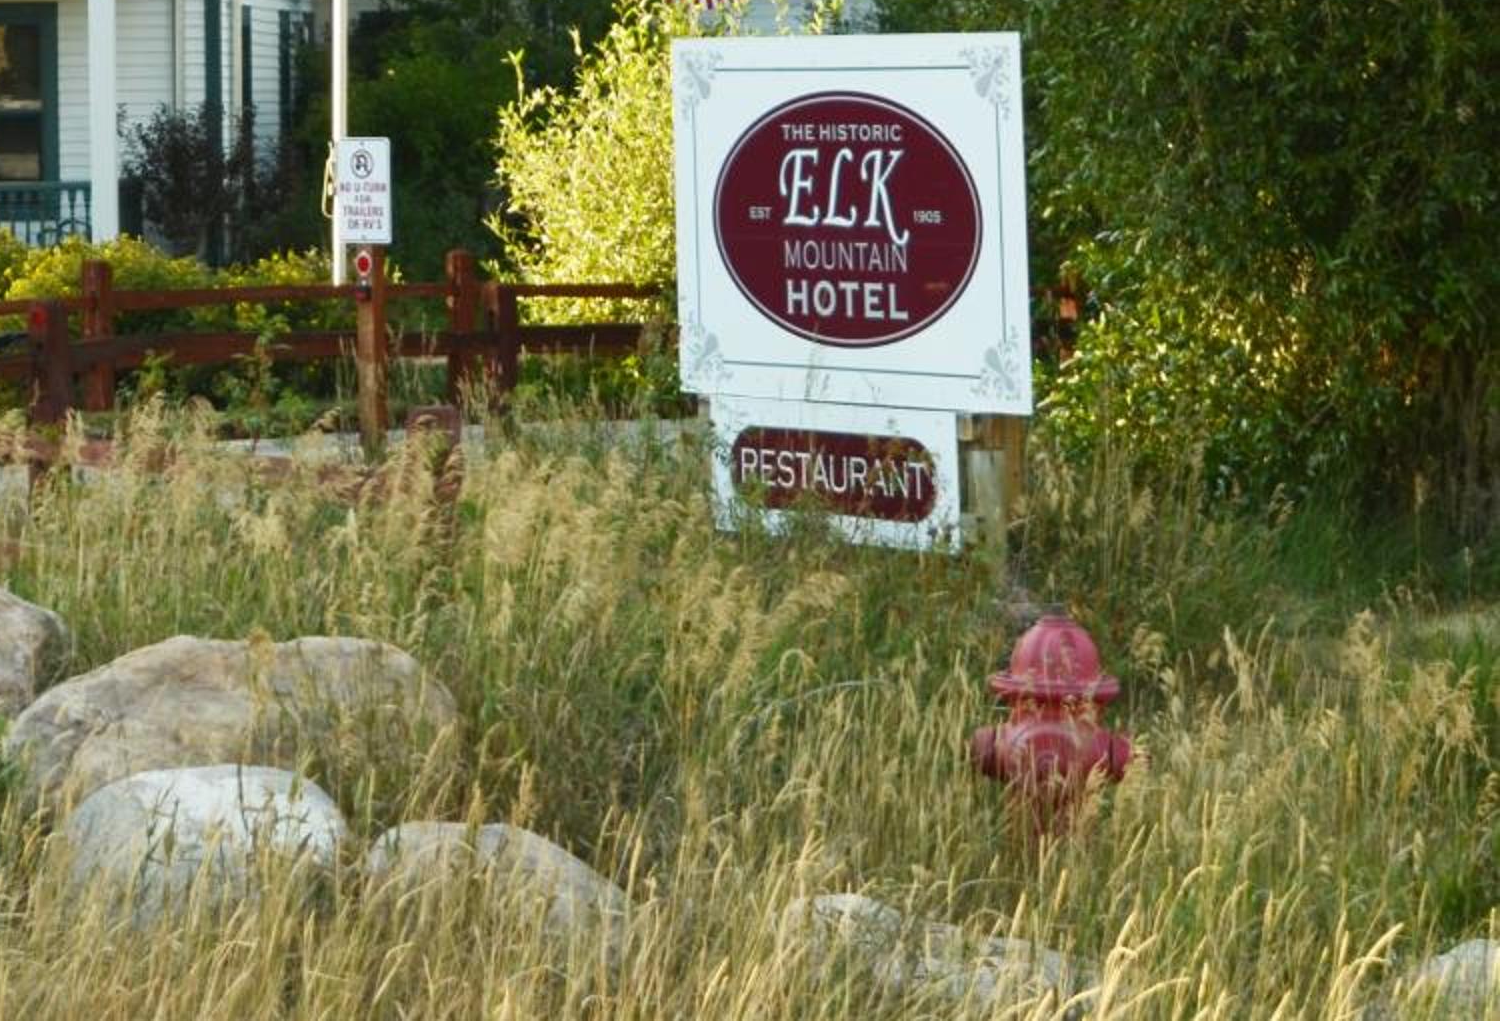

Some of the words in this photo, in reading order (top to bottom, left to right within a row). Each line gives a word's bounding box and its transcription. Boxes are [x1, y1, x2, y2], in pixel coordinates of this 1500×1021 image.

[781, 124, 816, 141] THE
[819, 124, 903, 142] HISTORIC
[749, 206, 773, 220] EST
[779, 147, 910, 245] ELK
[913, 210, 941, 224] 1905
[784, 239, 908, 273] MOUNTAIN
[786, 279, 909, 321] HOTEL
[740, 446, 927, 500] RESTAURANT
